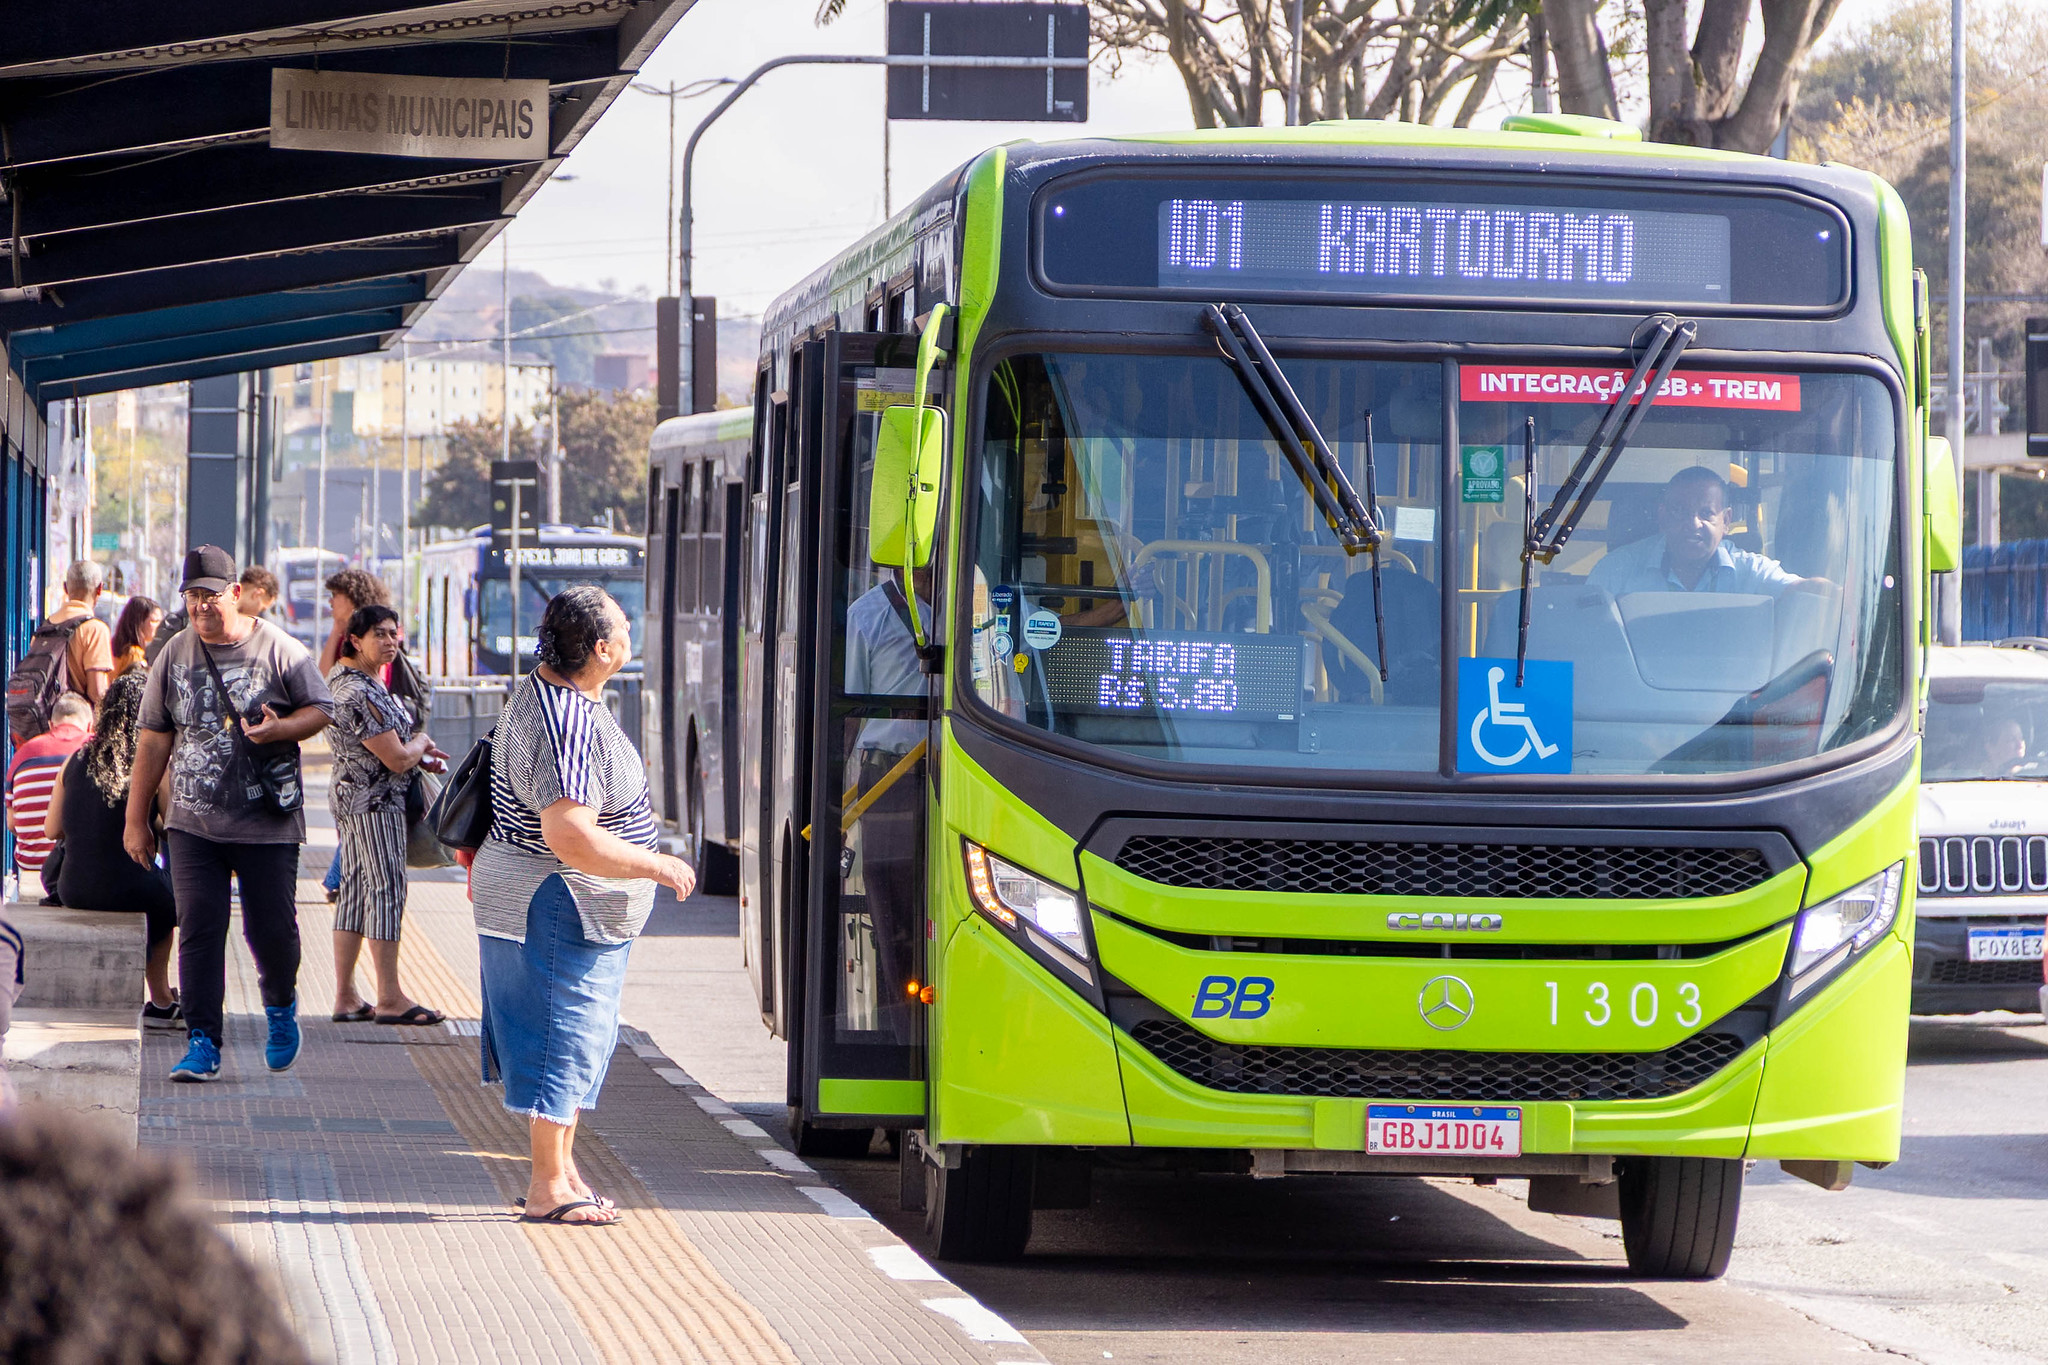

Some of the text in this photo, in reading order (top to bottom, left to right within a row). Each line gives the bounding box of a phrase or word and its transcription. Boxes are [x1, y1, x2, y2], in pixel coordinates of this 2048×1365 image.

[285, 89, 534, 140] LINHAS MUNICIPAIS
[1708, 378, 1782, 401] TREM
[1105, 638, 1236, 675] TARIFA
[1100, 674, 1145, 707] R$
[1386, 912, 1502, 931] CAIO
[1978, 937, 2043, 956] FOX8E3
[1191, 975, 1275, 1020] BB
[1545, 981, 1702, 1028] 1303
[1431, 1110, 1456, 1118] BRASIL
[1369, 1141, 1378, 1151] BR
[1382, 1121, 1504, 1150] GBJ1D04
